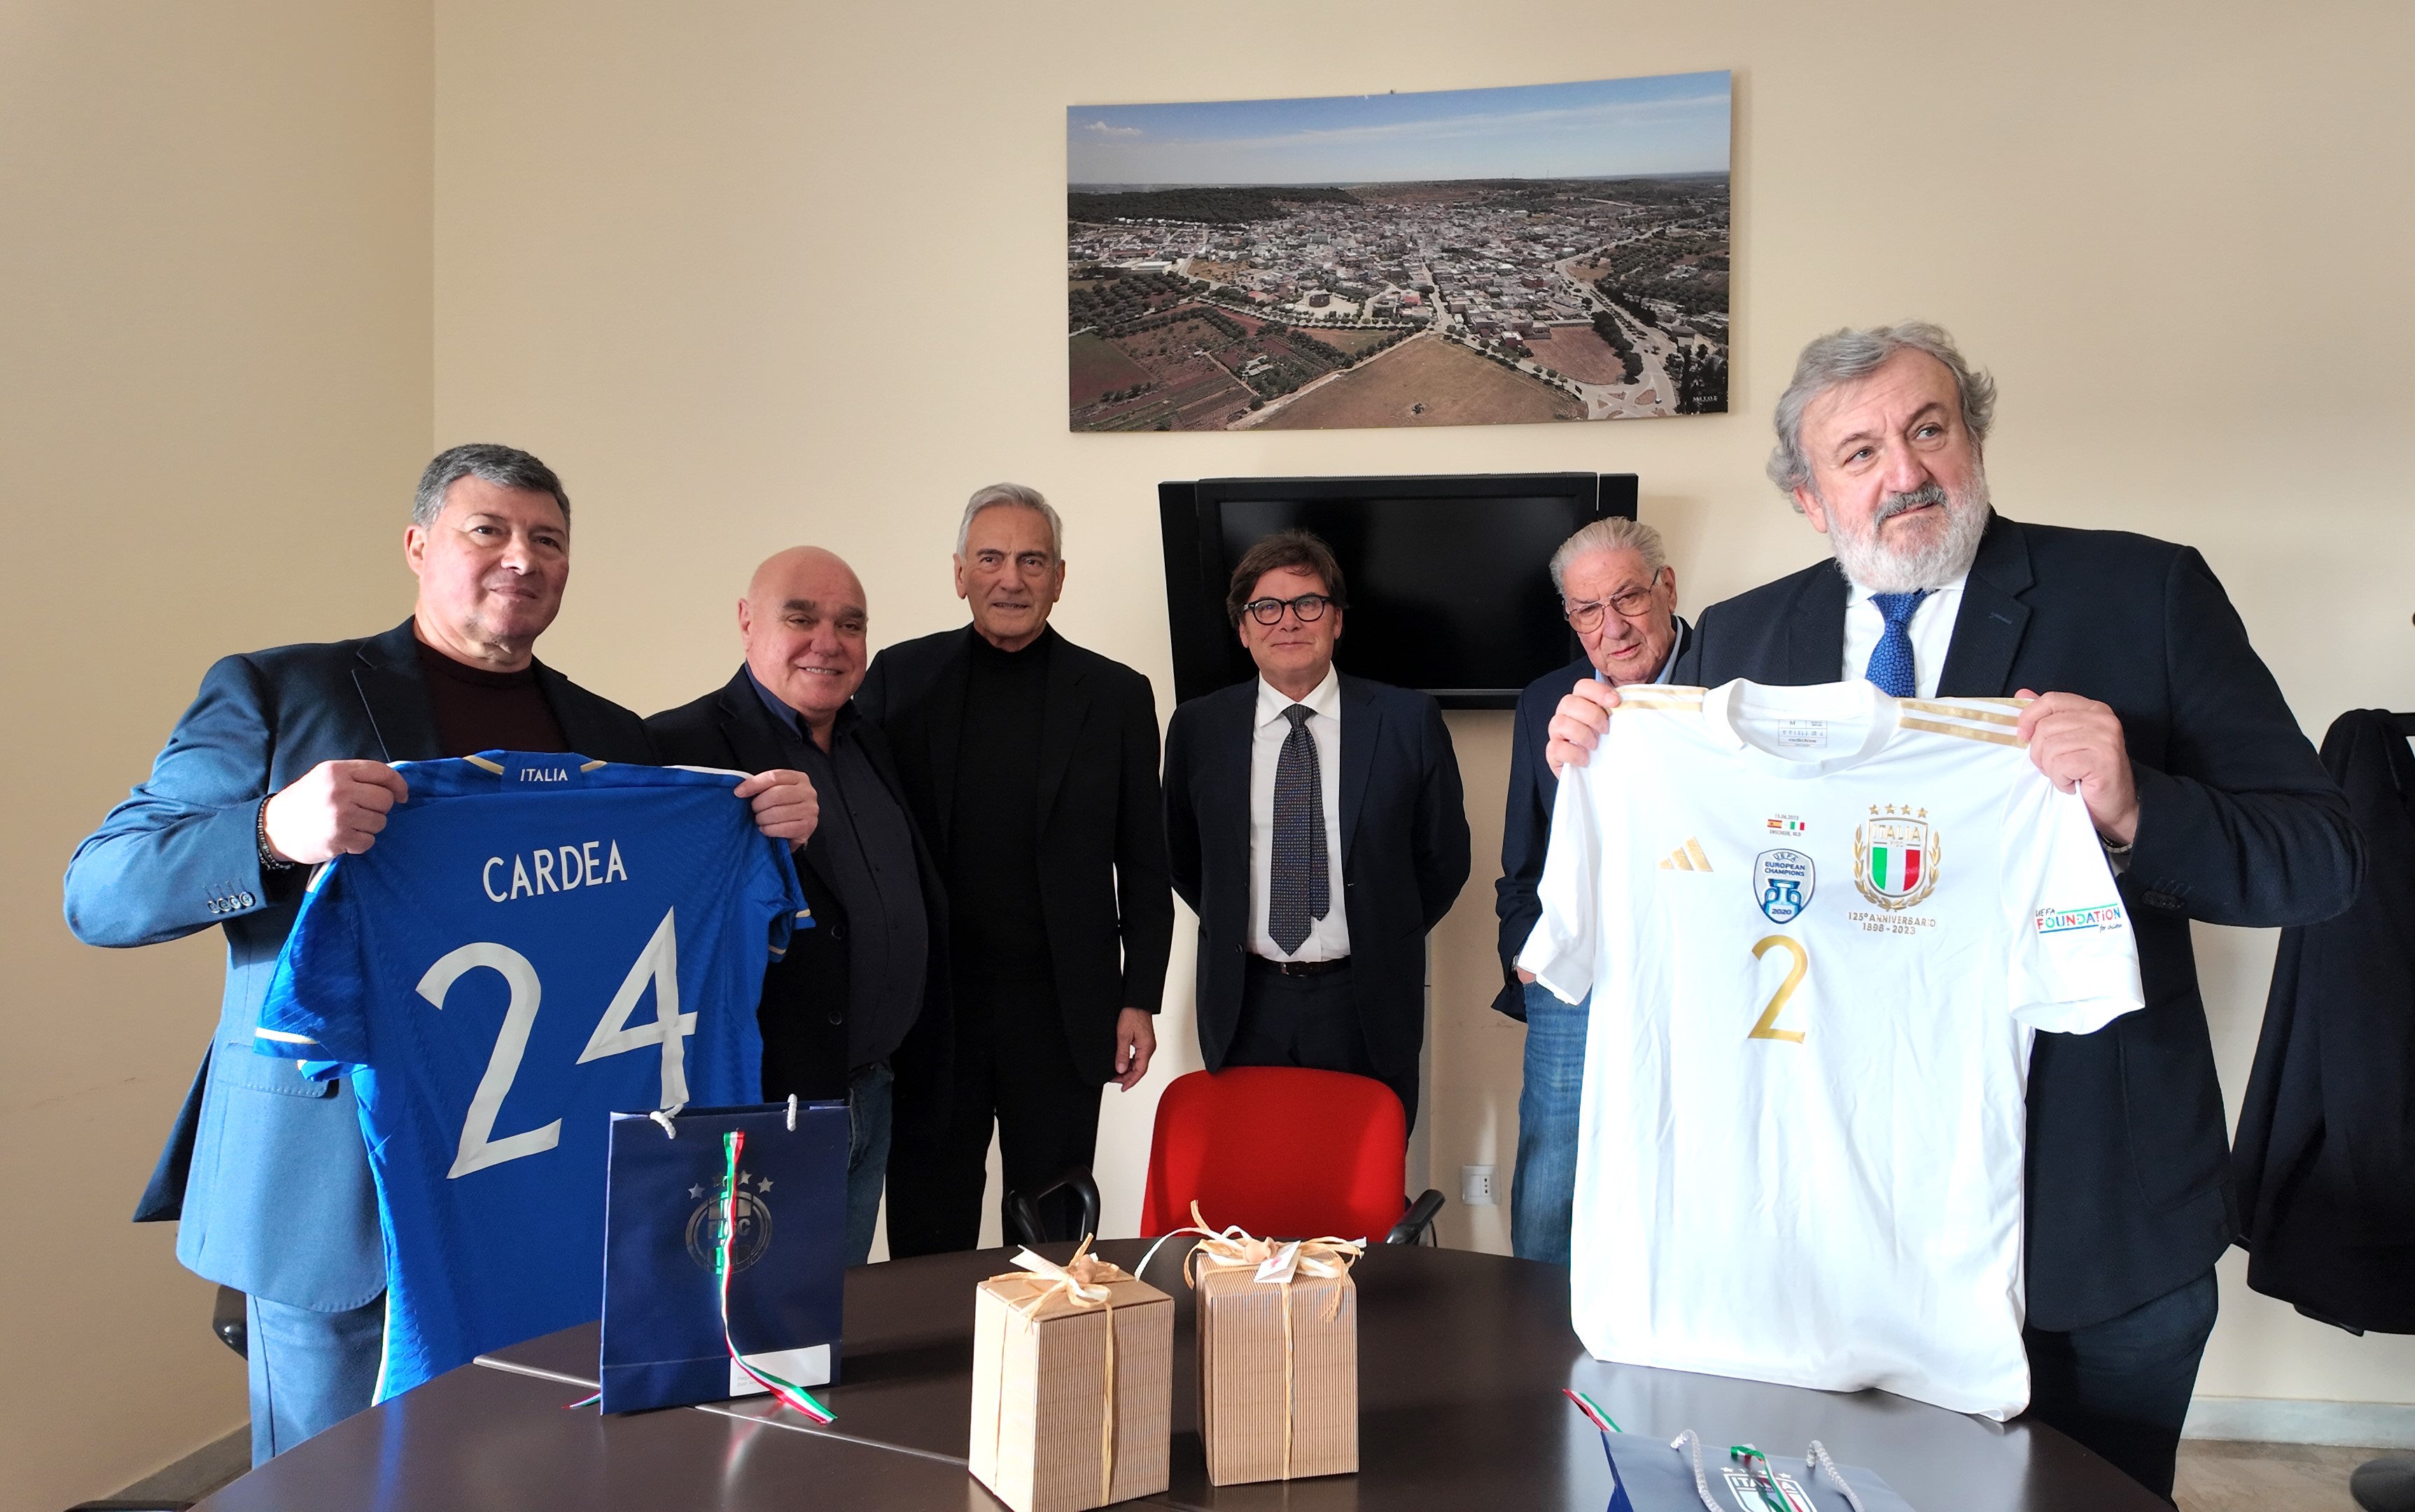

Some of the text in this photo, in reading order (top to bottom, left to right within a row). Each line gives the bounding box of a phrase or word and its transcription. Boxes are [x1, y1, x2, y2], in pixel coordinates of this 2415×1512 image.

[520, 768, 568, 782] ITALIA
[1872, 824, 1921, 841] ITALIA
[1772, 852, 1798, 863] UEFA
[482, 839, 627, 902] CARDEA
[1764, 867, 1805, 877] CHAMPIONS
[1765, 861, 1805, 871] EUROPEAN
[2035, 908, 2055, 917] UEFA
[2036, 907, 2121, 930] FOUNDATION
[1863, 923, 1884, 932] 1898
[1892, 925, 1916, 935] 2023
[1747, 934, 1808, 1044] 2
[415, 905, 699, 1180] 24
